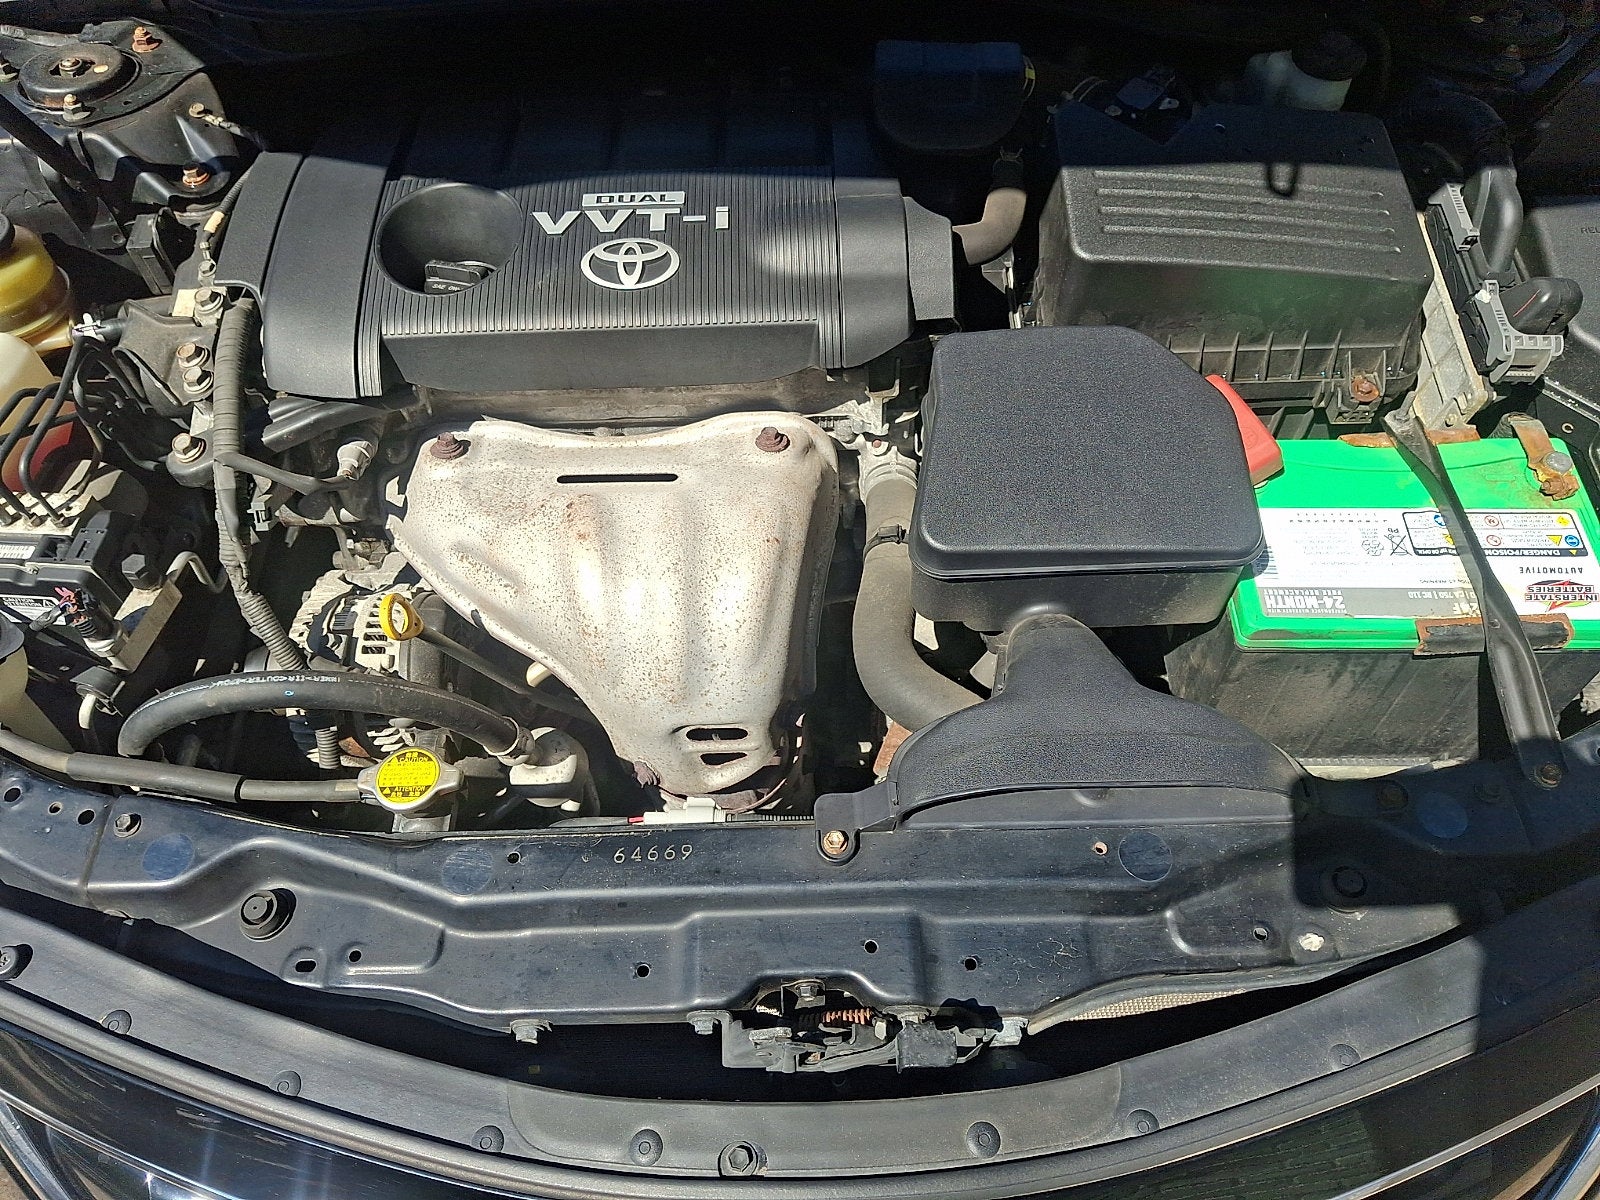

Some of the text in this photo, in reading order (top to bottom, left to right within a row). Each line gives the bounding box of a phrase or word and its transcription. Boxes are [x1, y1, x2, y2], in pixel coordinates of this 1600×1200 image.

[596, 193, 676, 204] DUAL
[532, 206, 729, 235] VVT-i
[1519, 566, 1583, 574] AUTOMOTIVE
[1264, 595, 1346, 609] 24-MONTH
[613, 844, 693, 864] 64669
